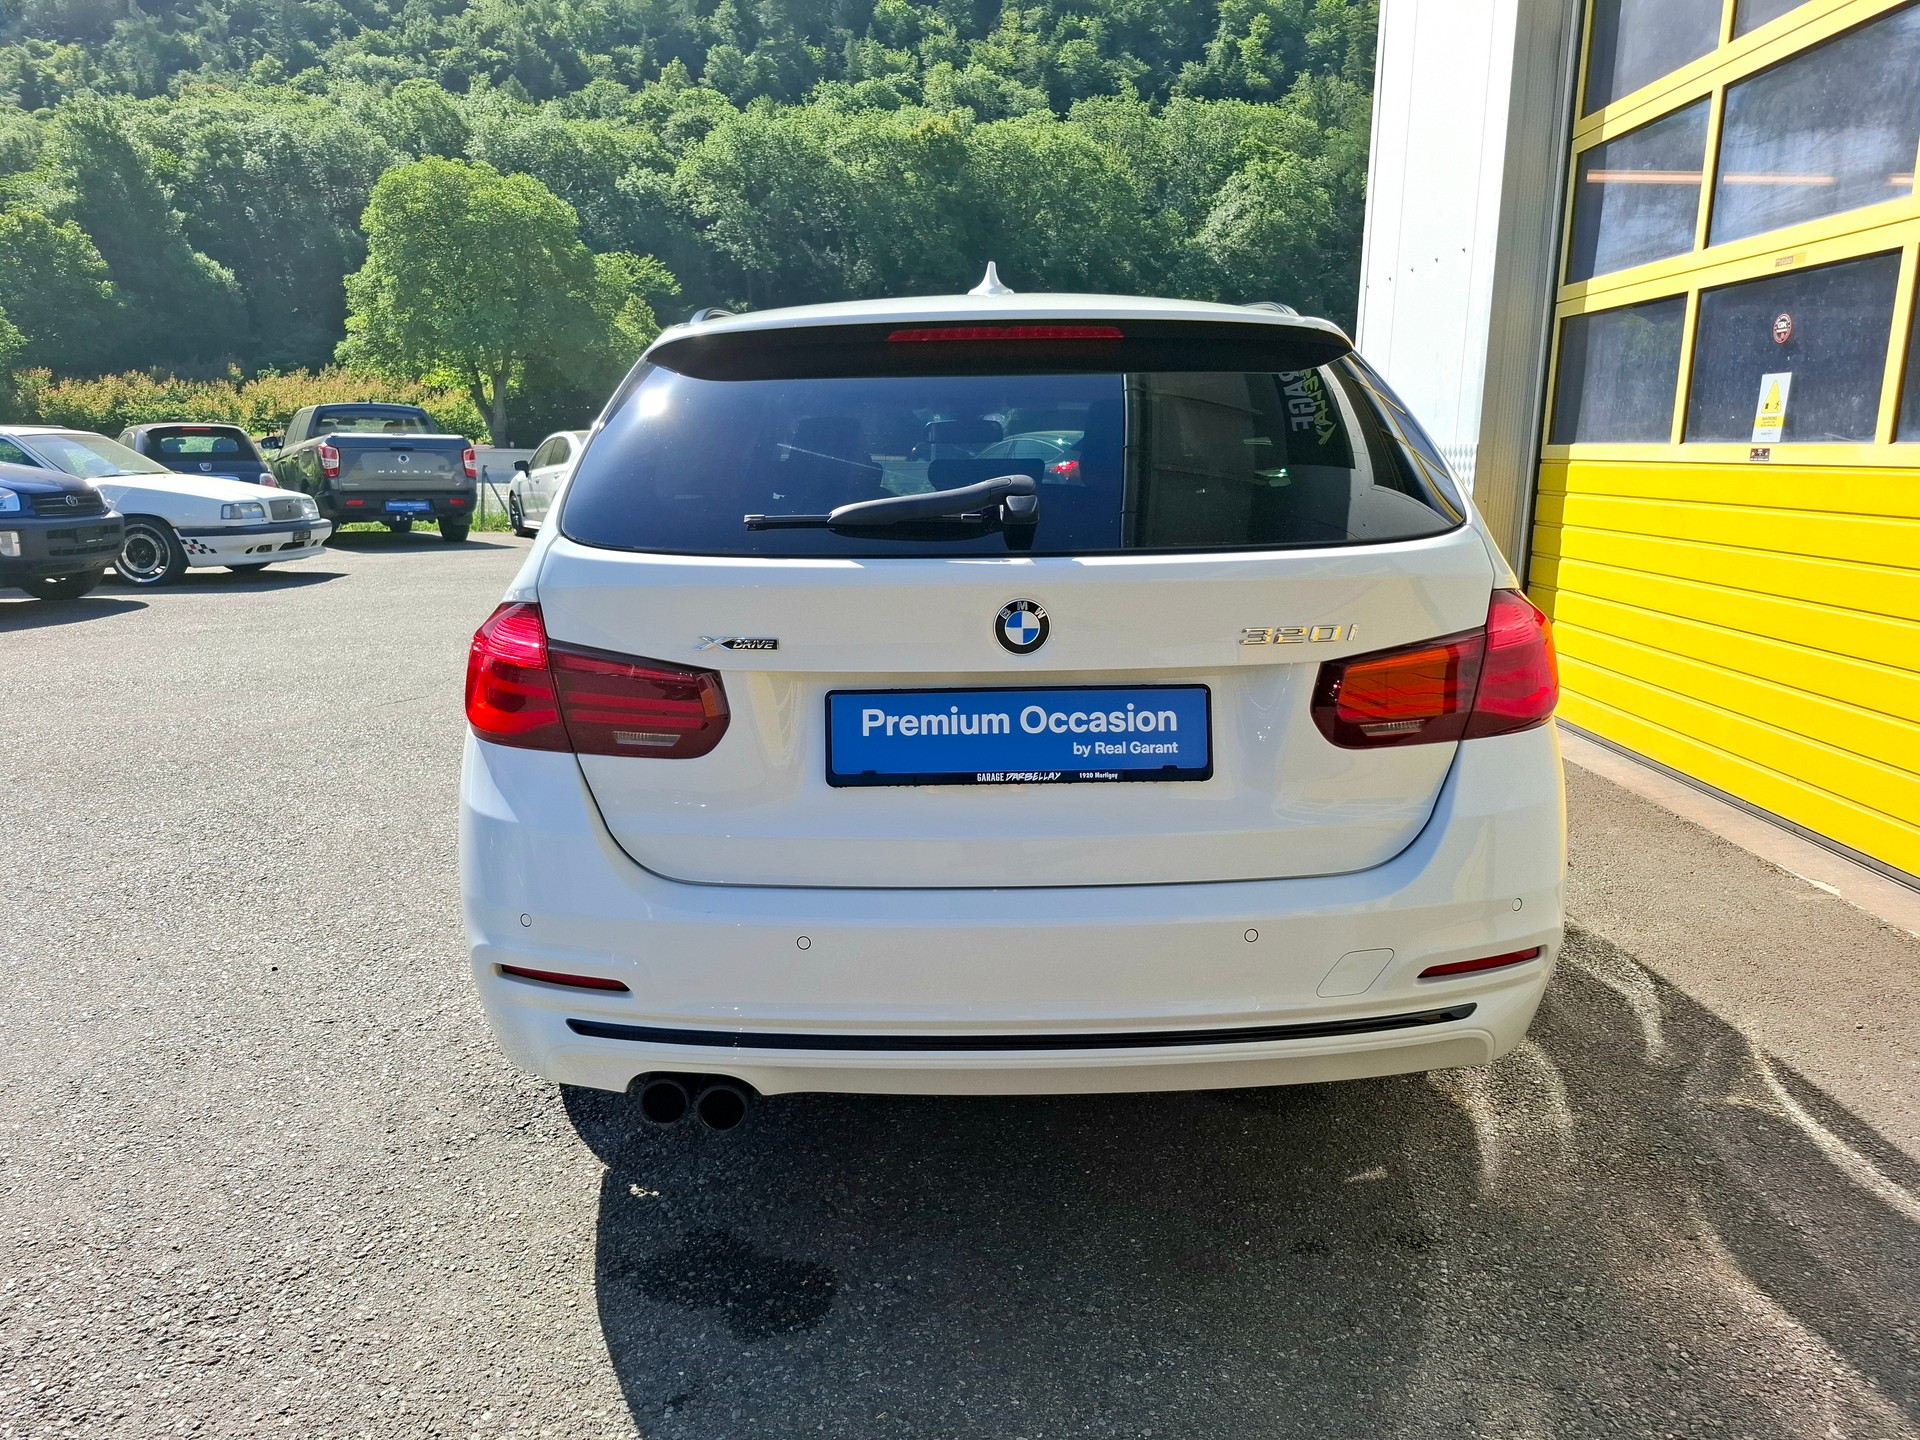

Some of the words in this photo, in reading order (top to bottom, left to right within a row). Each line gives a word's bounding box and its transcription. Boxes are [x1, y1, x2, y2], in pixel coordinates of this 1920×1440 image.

[1239, 623, 1359, 645] 320i
[862, 706, 1010, 737] Premium
[1020, 703, 1178, 734] Occasion
[1073, 742, 1091, 757] by
[1095, 741, 1126, 755] Real
[1130, 741, 1179, 754] Garant
[976, 773, 1005, 782] GARAGE
[1005, 772, 1062, 782] DARBELLAY
[1095, 772, 1119, 780] Martigny
